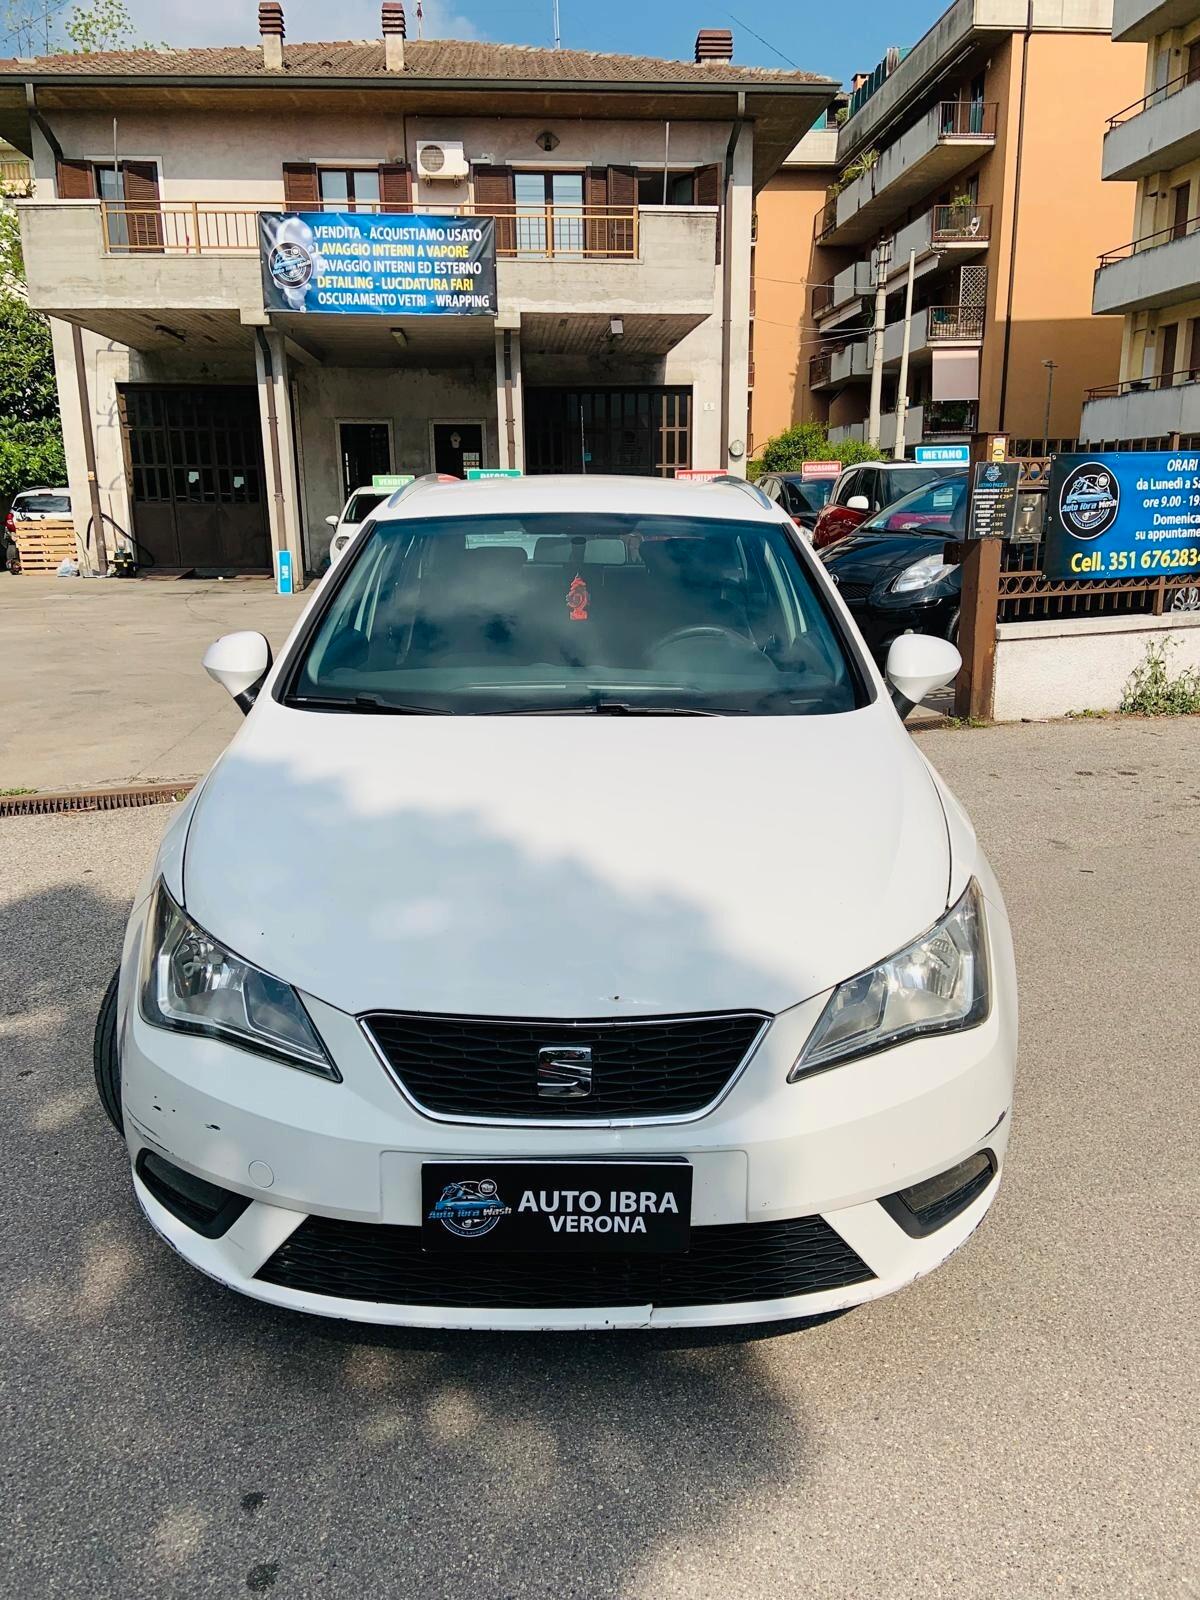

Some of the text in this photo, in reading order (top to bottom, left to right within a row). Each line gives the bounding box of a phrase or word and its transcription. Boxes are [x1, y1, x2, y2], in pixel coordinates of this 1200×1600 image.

[314, 226, 361, 239] VENDITA
[370, 227, 445, 241] ACQUISTIAMO
[447, 228, 482, 242] USATO
[315, 242, 469, 258] LAVAGGIO INTERNI A VAPORE
[317, 259, 371, 273] LAVAGGIO
[374, 260, 415, 273] INTERNI
[418, 261, 432, 274] ED
[434, 262, 482, 275] ESTERNO
[317, 275, 373, 289] DETAILING
[382, 277, 448, 291] LUCIDATURA
[451, 278, 473, 291] FARI
[318, 292, 396, 306] OSCURAMENTO
[398, 294, 426, 307] VETRI
[436, 294, 489, 308] WRAPPING
[922, 450, 962, 460] METANO
[1167, 459, 1198, 471] ORARI
[1136, 478, 1148, 490] da
[1150, 477, 1183, 490] Lunedì
[1185, 480, 1191, 490] a
[1143, 498, 1159, 508] ore
[1161, 495, 1181, 508] 9.00
[1153, 512, 1200, 525] Domenica
[1135, 531, 1146, 540] su
[1071, 548, 1200, 572] Cell. 351 676283
[518, 1191, 679, 1214] AUTO IBRA
[482, 1207, 512, 1216] Wash
[549, 1215, 647, 1233] VERONA
